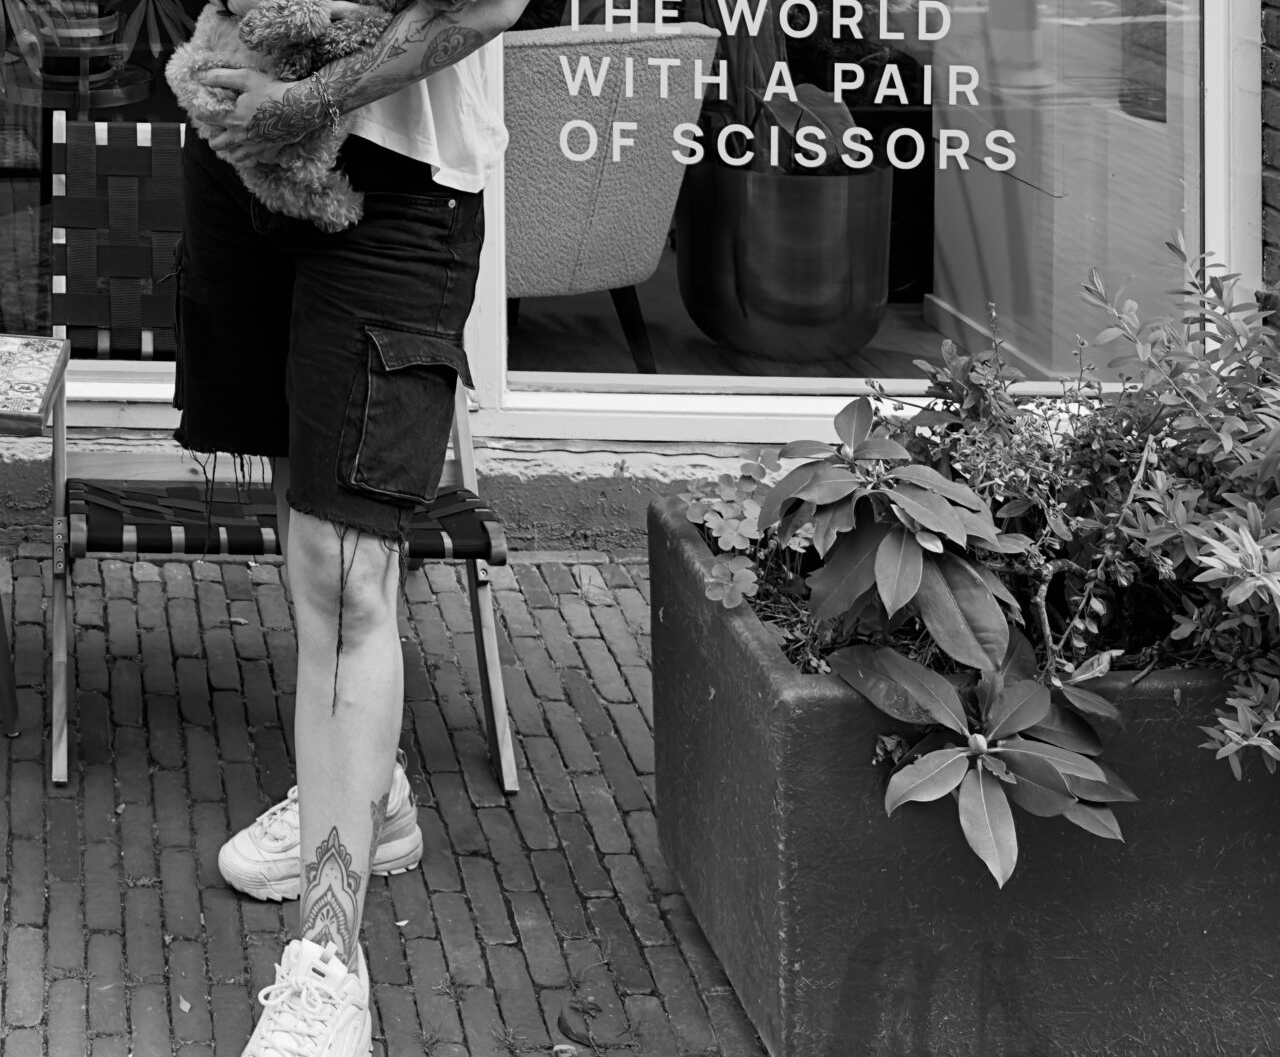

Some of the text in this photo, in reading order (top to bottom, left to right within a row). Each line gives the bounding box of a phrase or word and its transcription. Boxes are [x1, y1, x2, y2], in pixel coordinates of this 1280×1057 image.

[558, 55, 980, 106] WITH A PAIR
[558, 119, 1017, 172] OF SCISSORS
